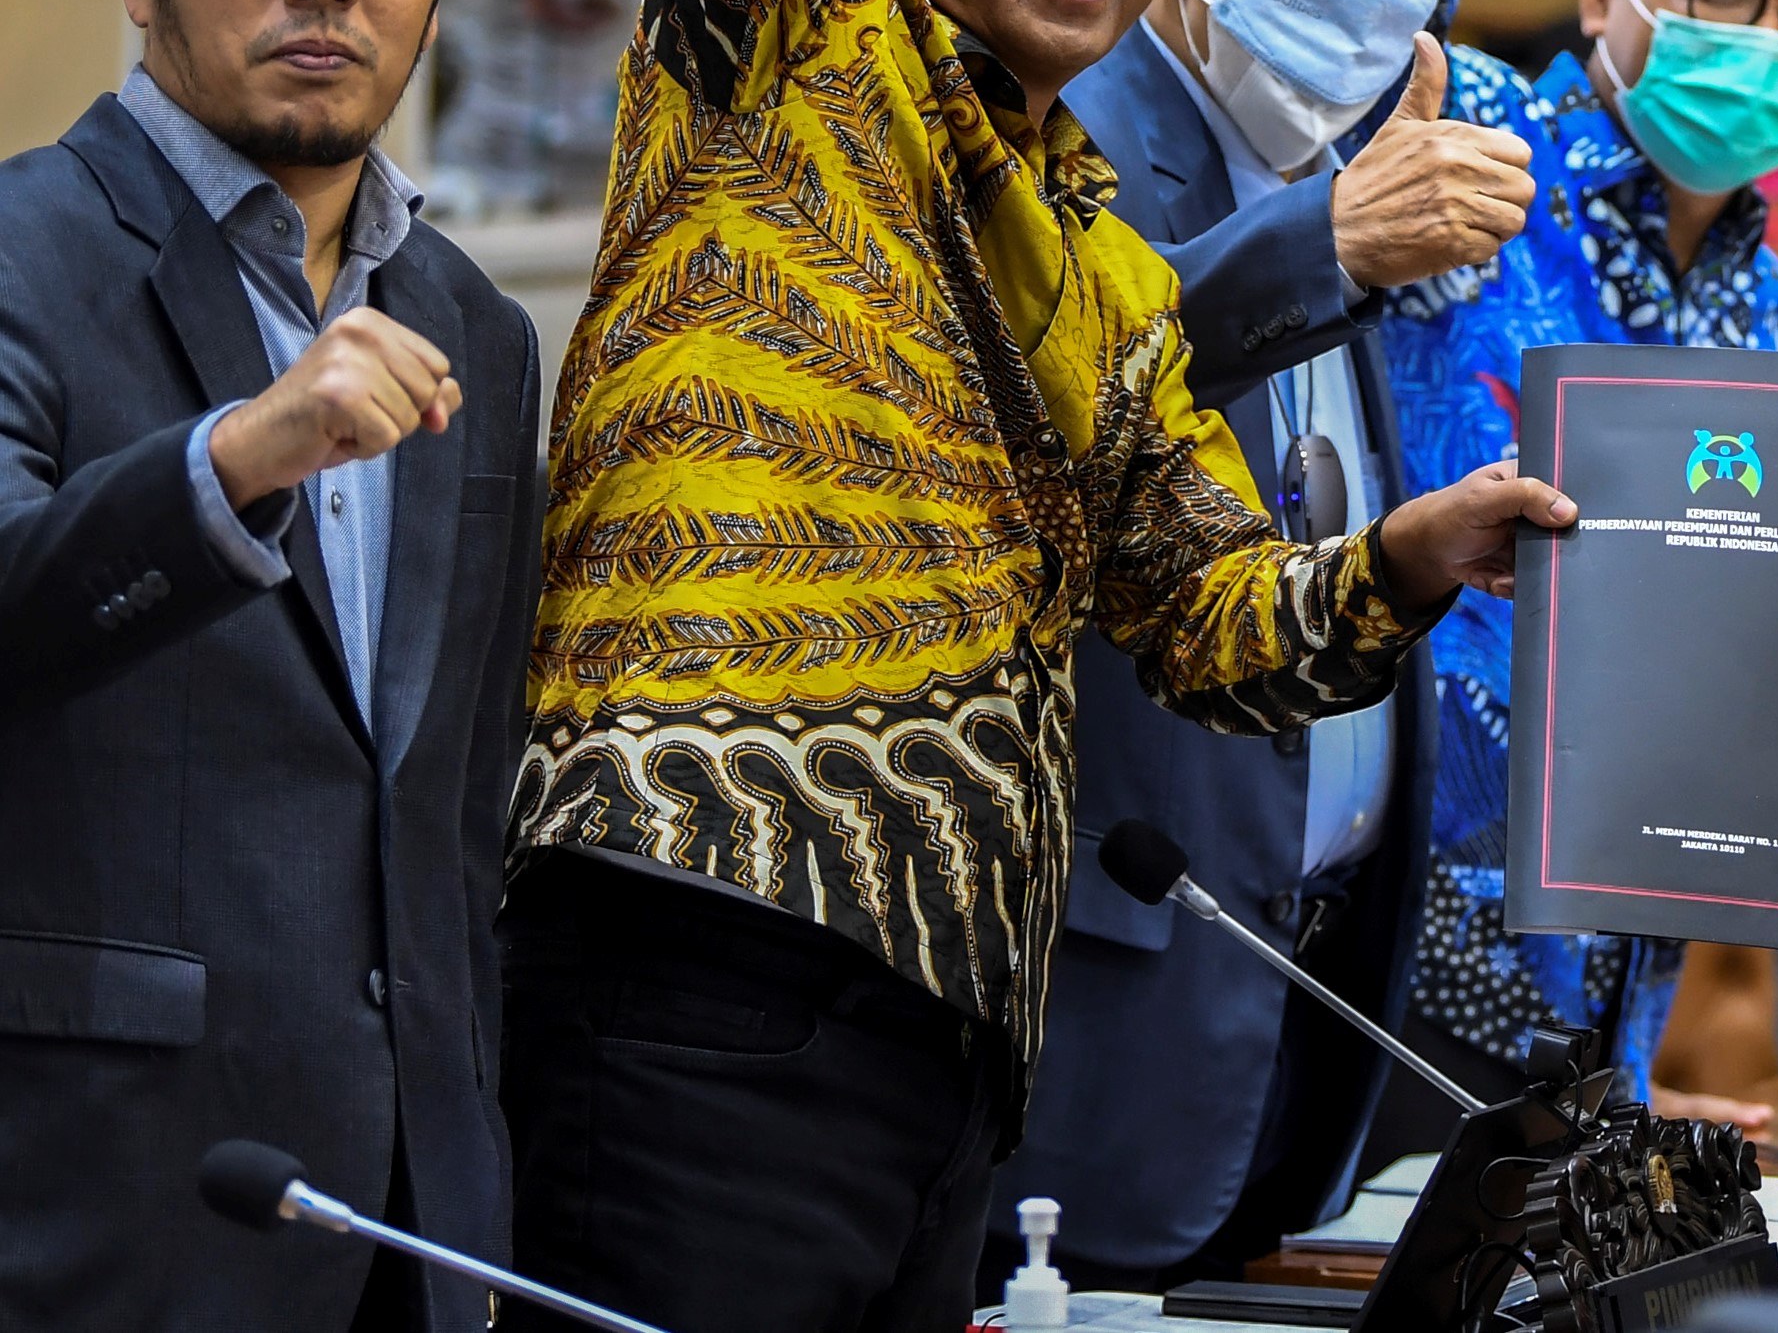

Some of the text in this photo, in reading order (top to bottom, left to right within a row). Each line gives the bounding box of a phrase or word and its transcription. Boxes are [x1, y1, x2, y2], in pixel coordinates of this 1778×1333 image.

[1686, 508, 1760, 523] KEMENTERIAN
[1579, 519, 1662, 531] PEMBERDAYAAN
[1664, 520, 1727, 535] PEREMPUAN
[1729, 524, 1752, 537] DAN
[1666, 534, 1778, 552] REPUBLIK INDONESIA
[1642, 826, 1654, 835] JL.
[1655, 827, 1686, 838] MEDAN
[1687, 829, 1727, 842] MERDEKA
[1728, 833, 1755, 844] BARAT
[1756, 836, 1771, 846] NO.
[1681, 840, 1745, 854] JAKARTA 10110
